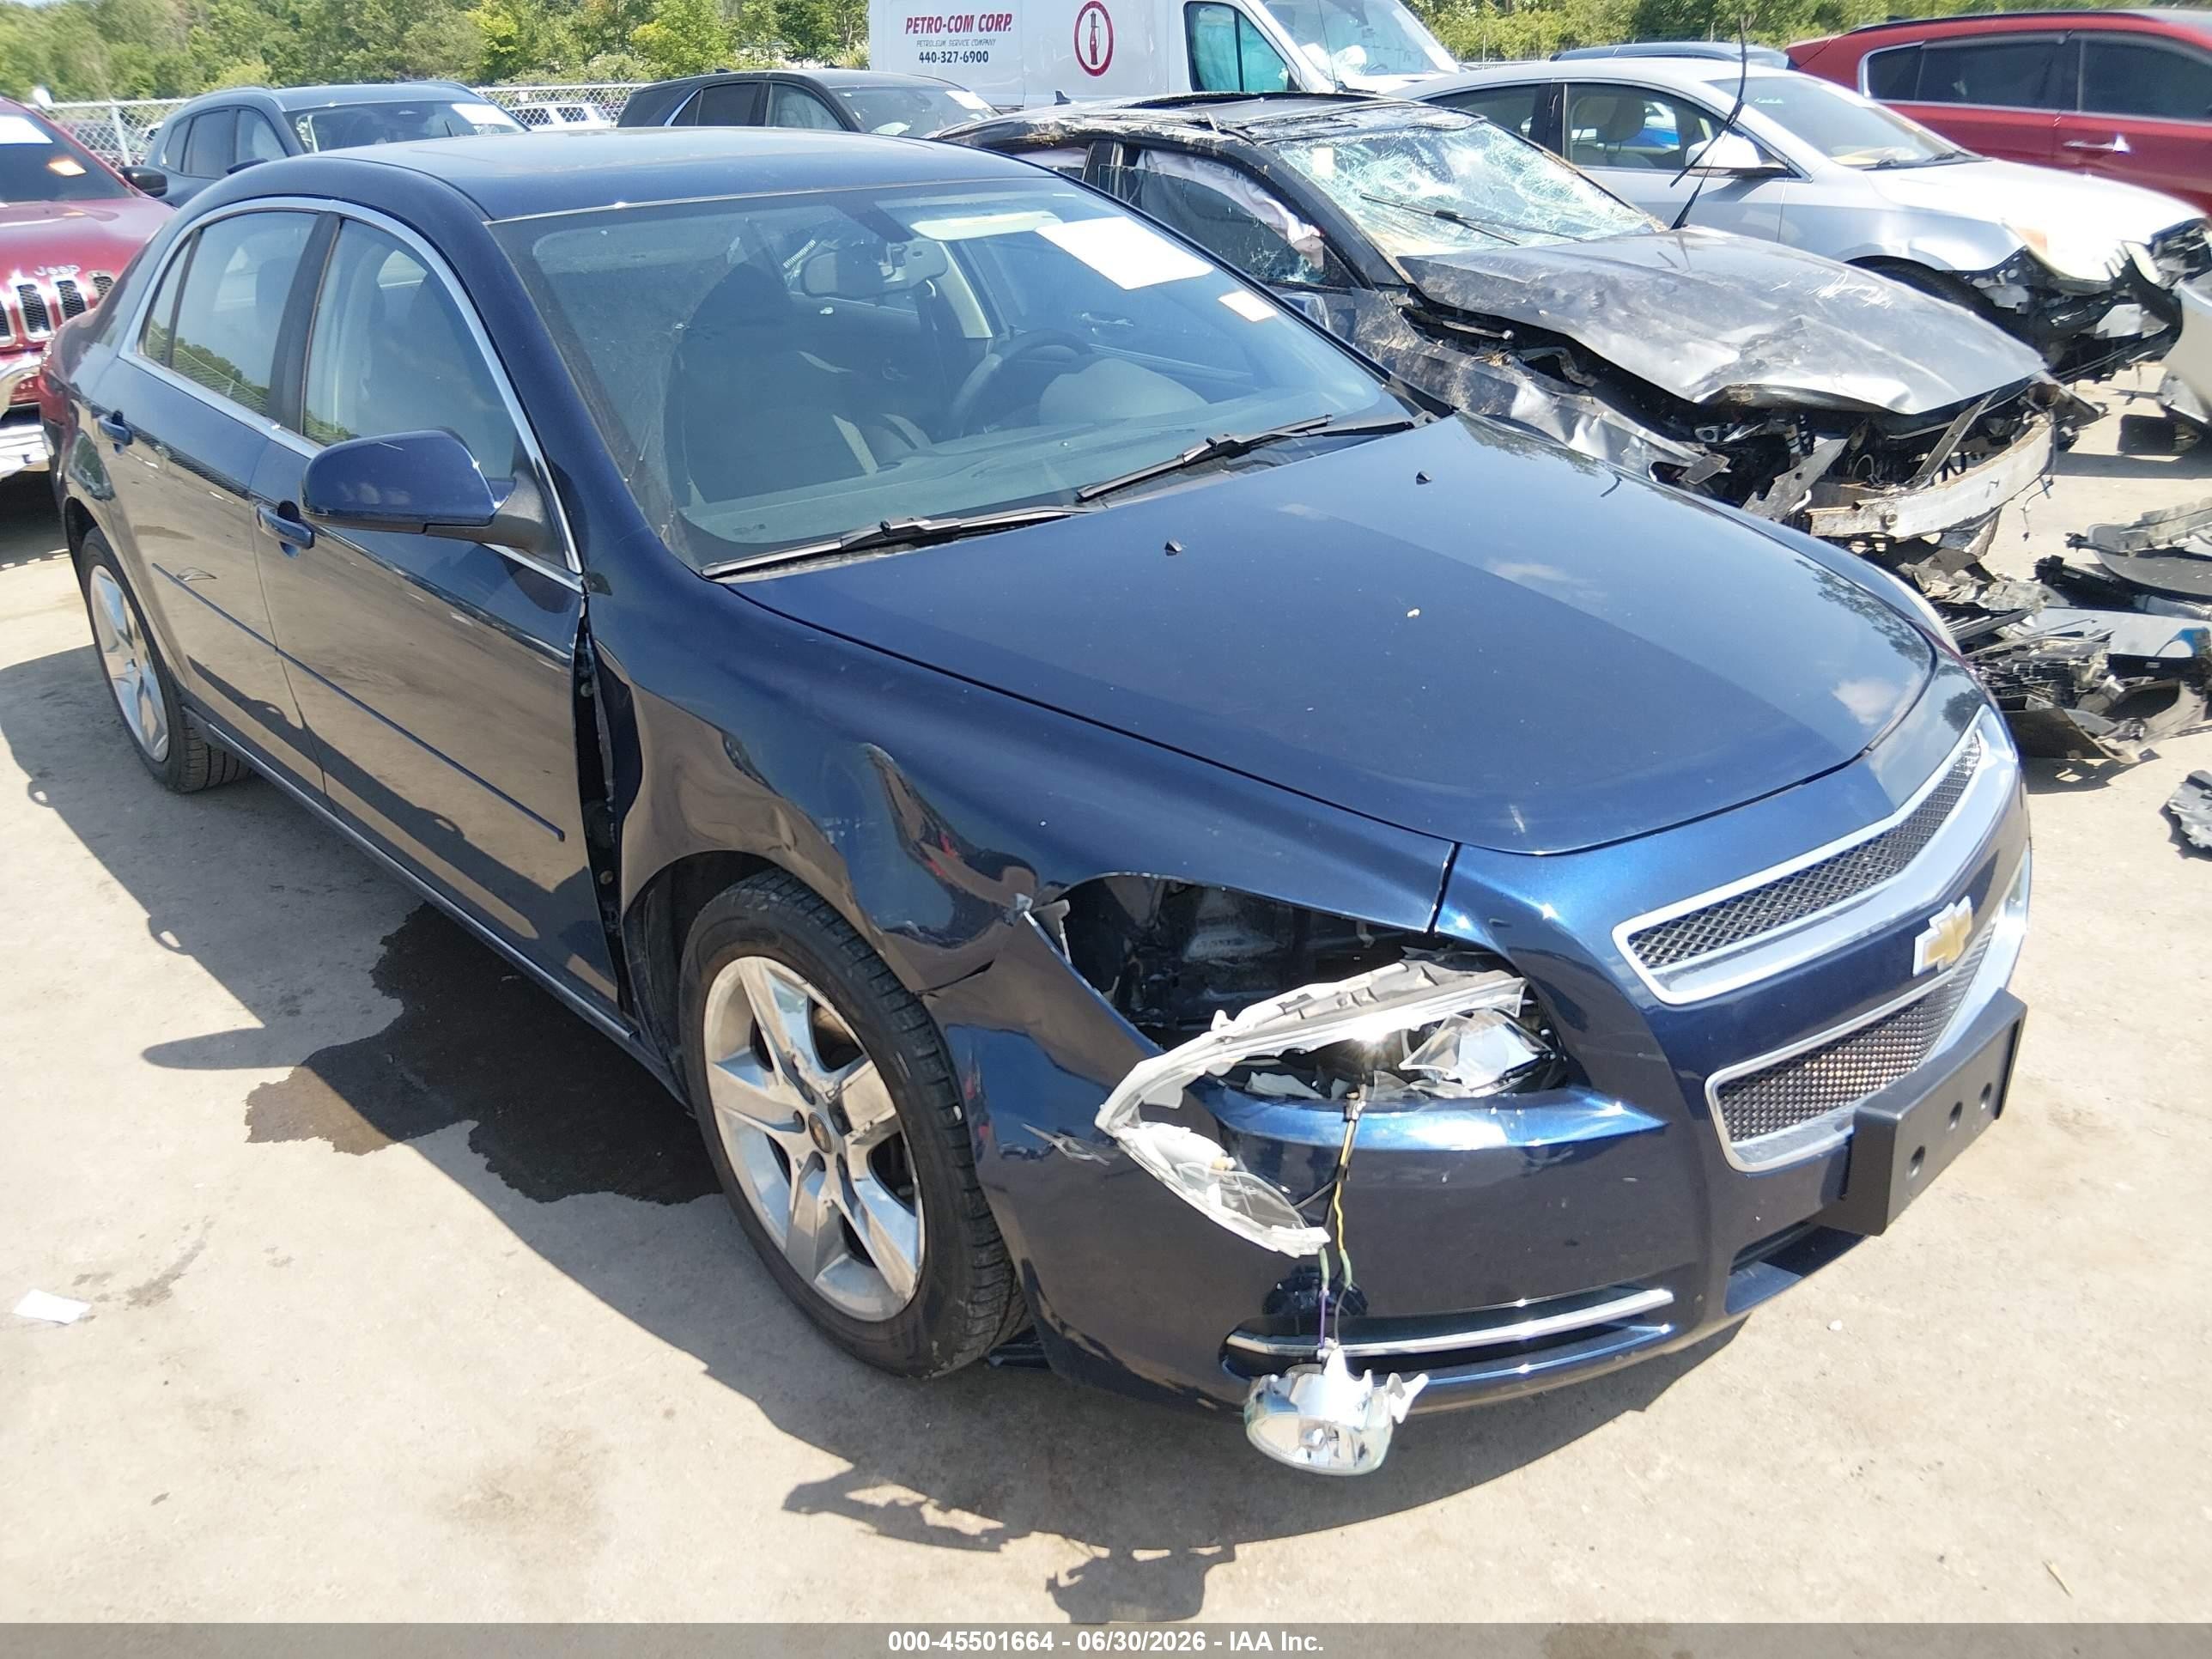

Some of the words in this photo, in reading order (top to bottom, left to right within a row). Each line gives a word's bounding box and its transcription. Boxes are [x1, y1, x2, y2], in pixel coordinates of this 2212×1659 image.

[905, 15, 975, 34] PETRO-COM
[978, 13, 1013, 33] CORP.
[971, 38, 997, 46] COMPANY
[919, 50, 989, 64] 440-327-6900
[33, 264, 82, 276] Jeep
